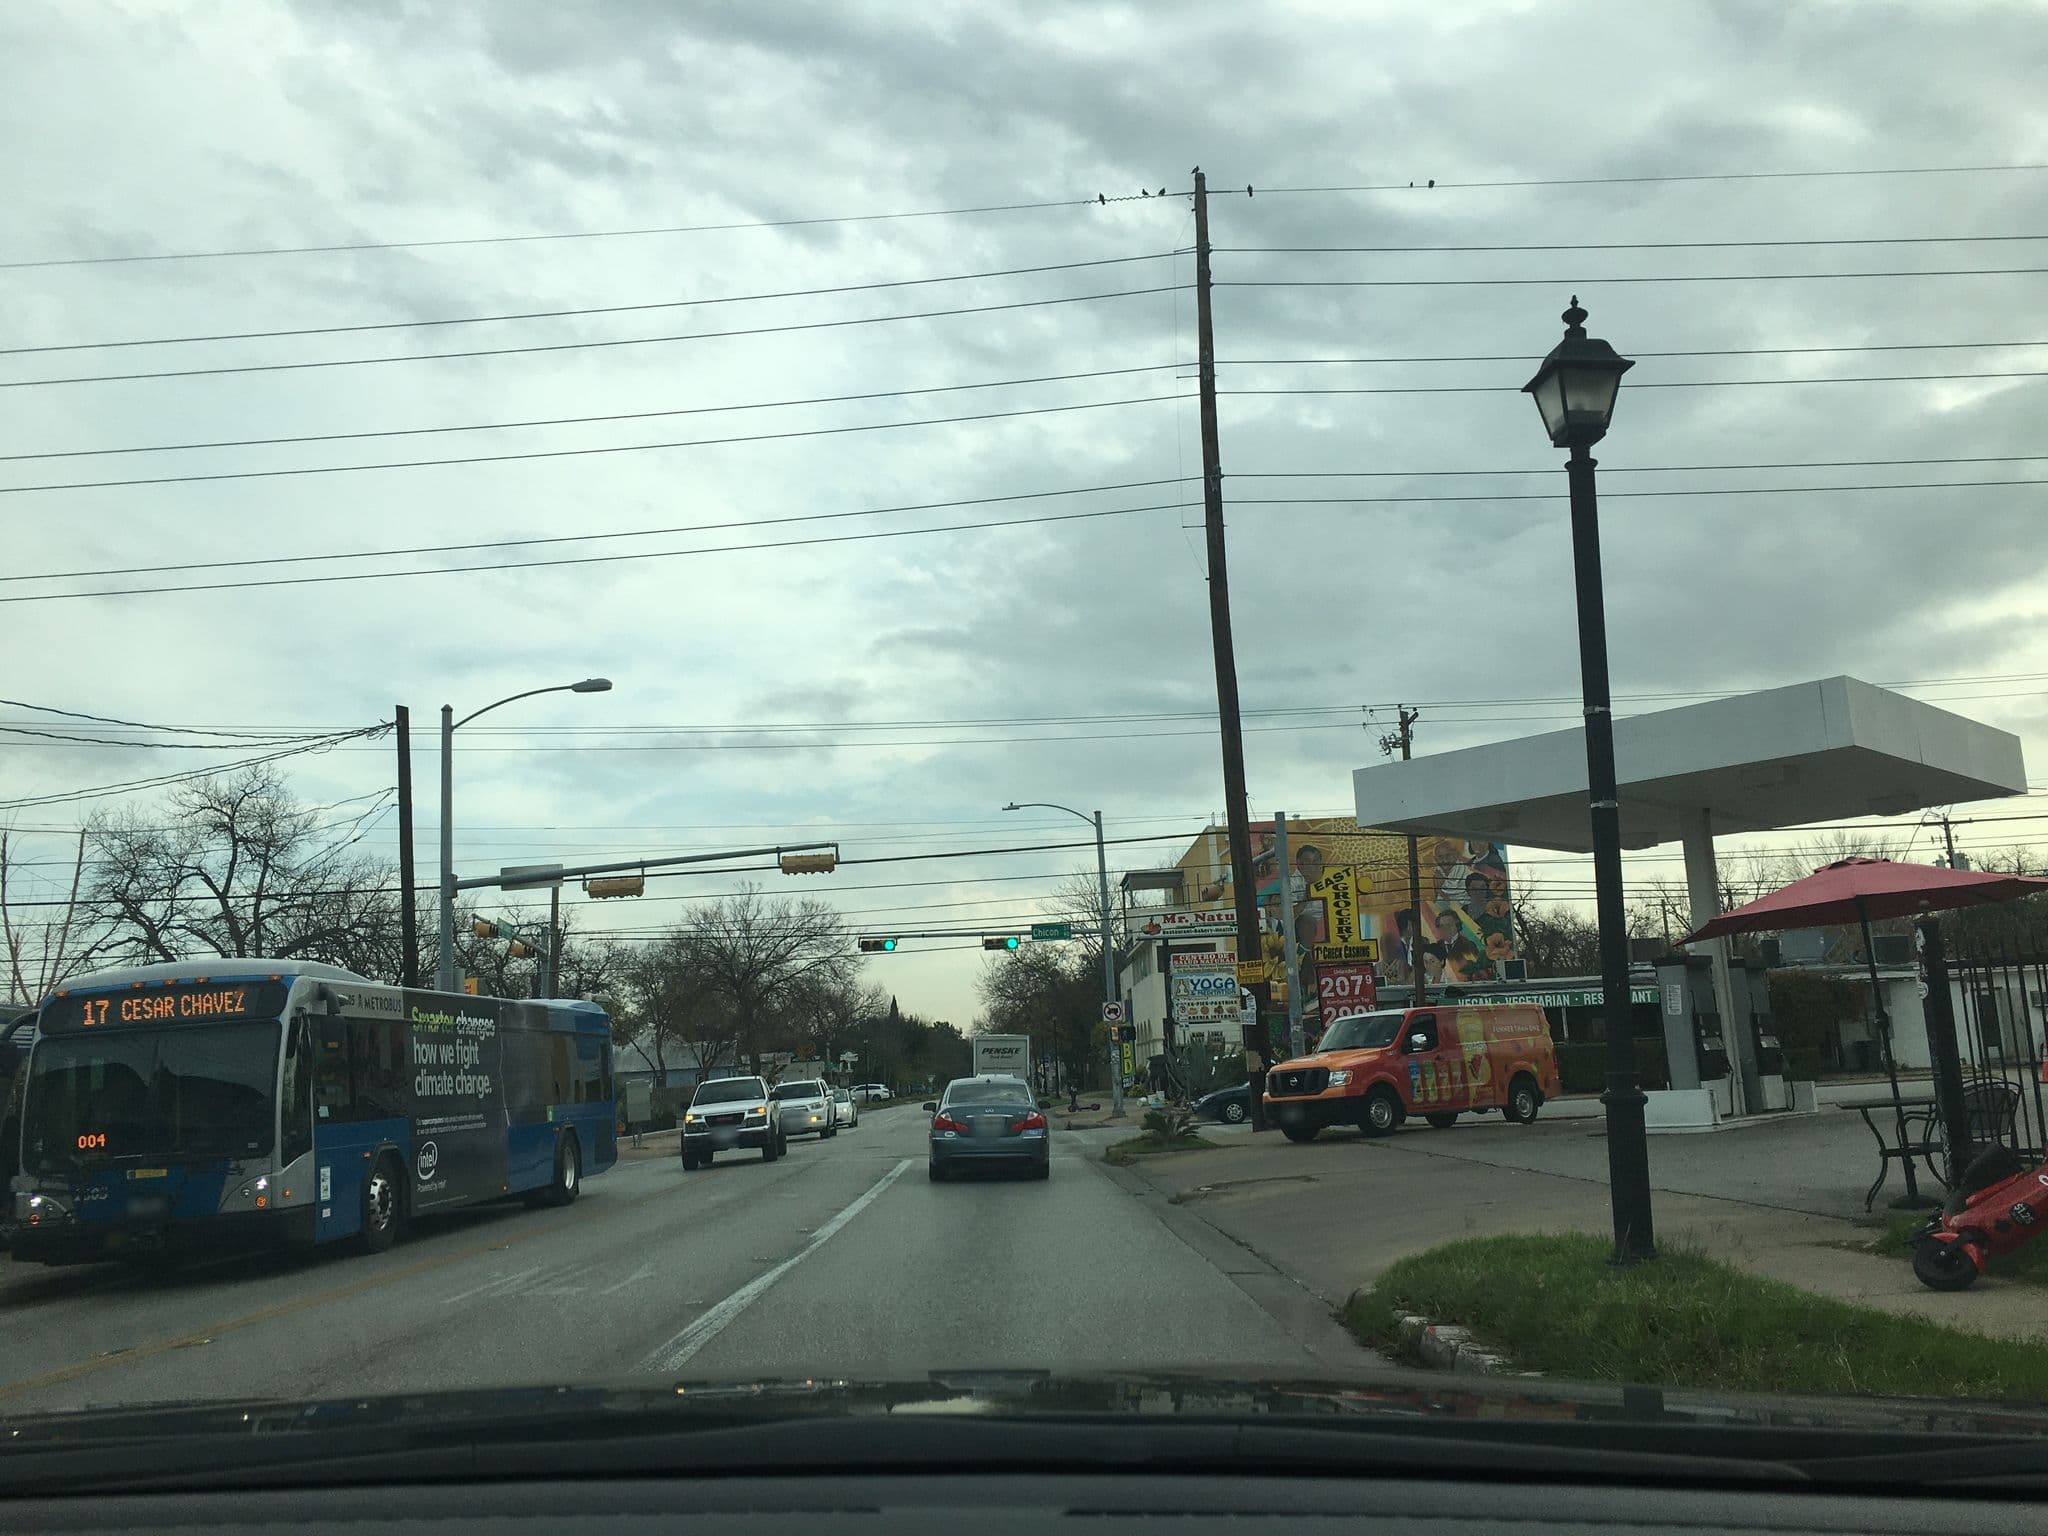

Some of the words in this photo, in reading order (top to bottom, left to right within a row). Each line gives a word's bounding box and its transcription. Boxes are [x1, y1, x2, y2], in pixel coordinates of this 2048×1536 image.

[1314, 868, 1351, 891] EAST
[1162, 913, 1189, 924] Mr.
[1332, 883, 1352, 942] GROCERY
[1033, 928, 1060, 938] Chicon
[1190, 977, 1236, 991] YOGA
[1320, 975, 1363, 998] 207
[1365, 975, 1372, 984] 9
[83, 1000, 110, 1025] 17
[121, 997, 175, 1021] CESAR
[180, 991, 245, 1017] CHAVEZ
[364, 996, 402, 1012] METROBUS
[1458, 997, 1492, 1005] VEGAN
[1505, 994, 1570, 1007] VEGETARIAN
[413, 1037, 437, 1064] how
[440, 1045, 454, 1064] we
[456, 1039, 480, 1069] fight
[415, 1069, 454, 1096] climate
[455, 1068, 492, 1098] change.
[78, 1134, 105, 1149] 004
